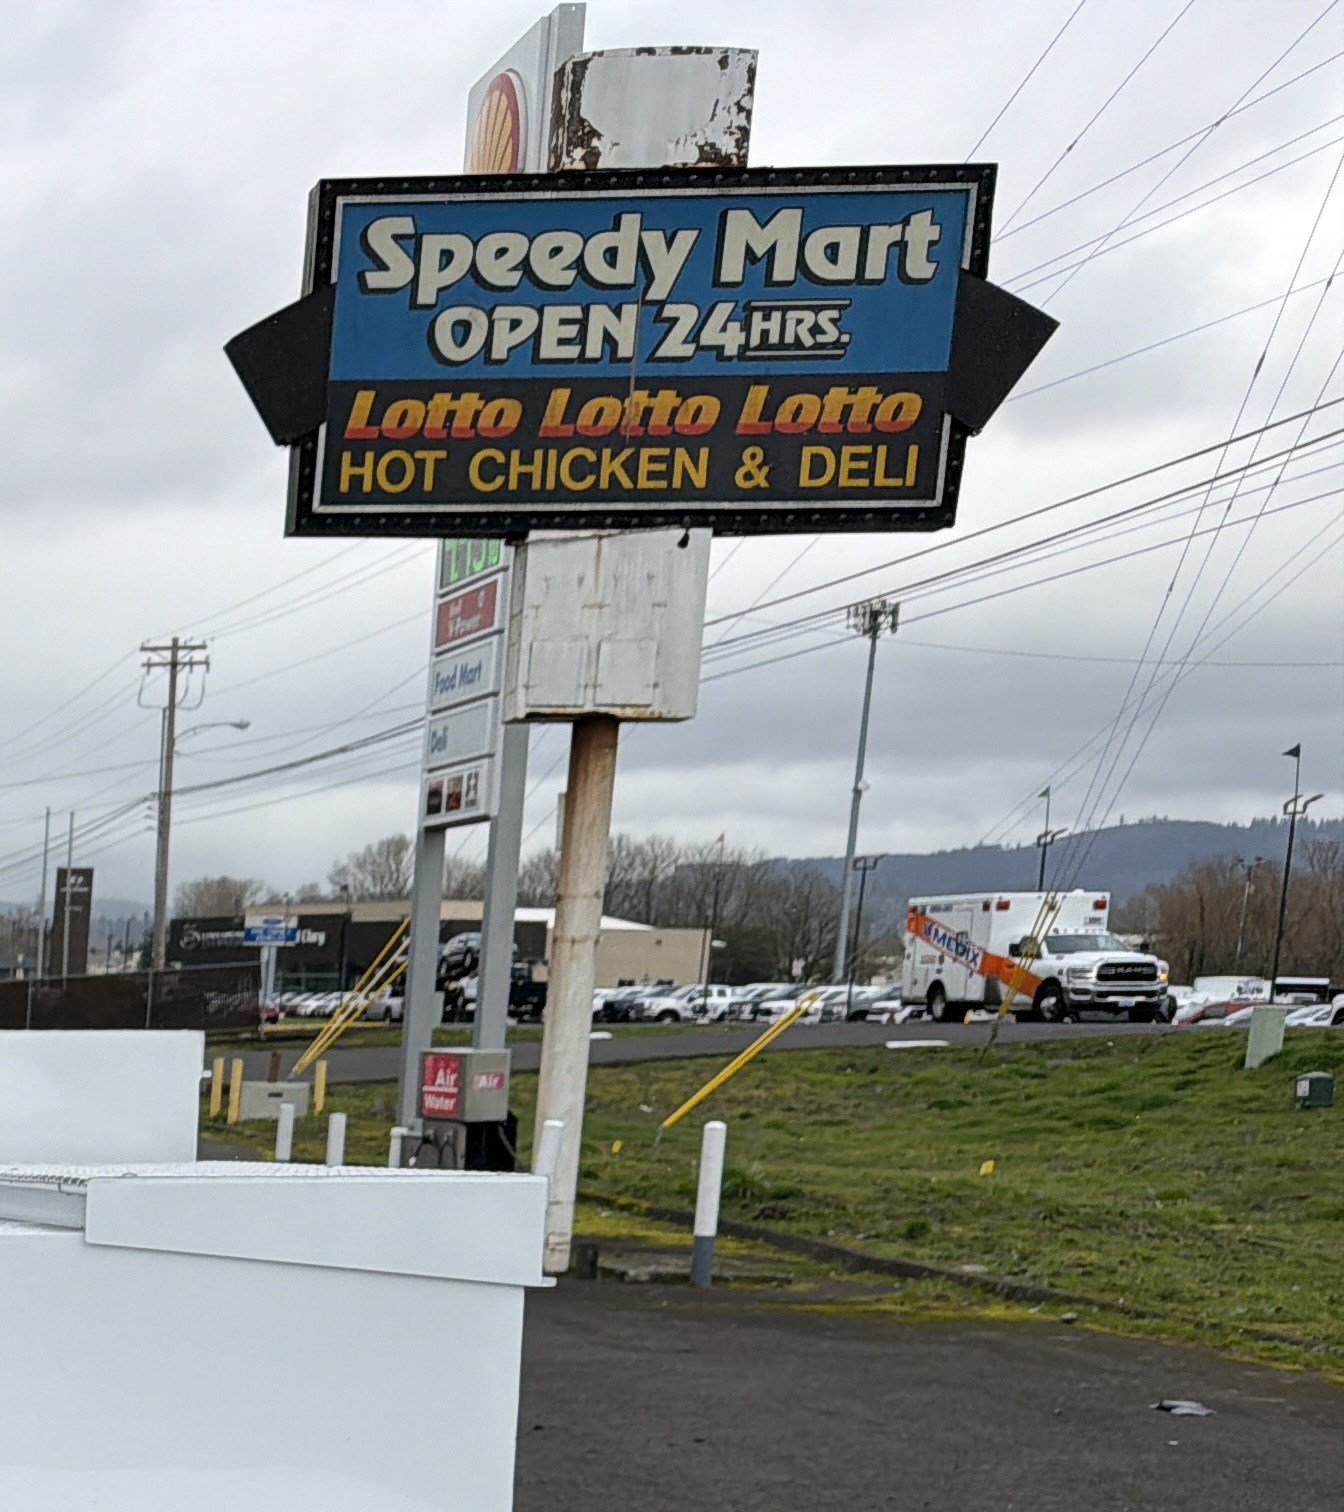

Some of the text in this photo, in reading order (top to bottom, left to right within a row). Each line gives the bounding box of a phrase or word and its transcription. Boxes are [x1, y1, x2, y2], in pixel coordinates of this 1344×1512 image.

[362, 208, 941, 306] Speedy Mart
[430, 304, 640, 364] OPEN
[343, 384, 924, 440] Lotto Lotto Lotto
[337, 444, 919, 494] HOT CHICKEN & DELI
[434, 1068, 459, 1088] Air
[477, 1073, 500, 1089] Air
